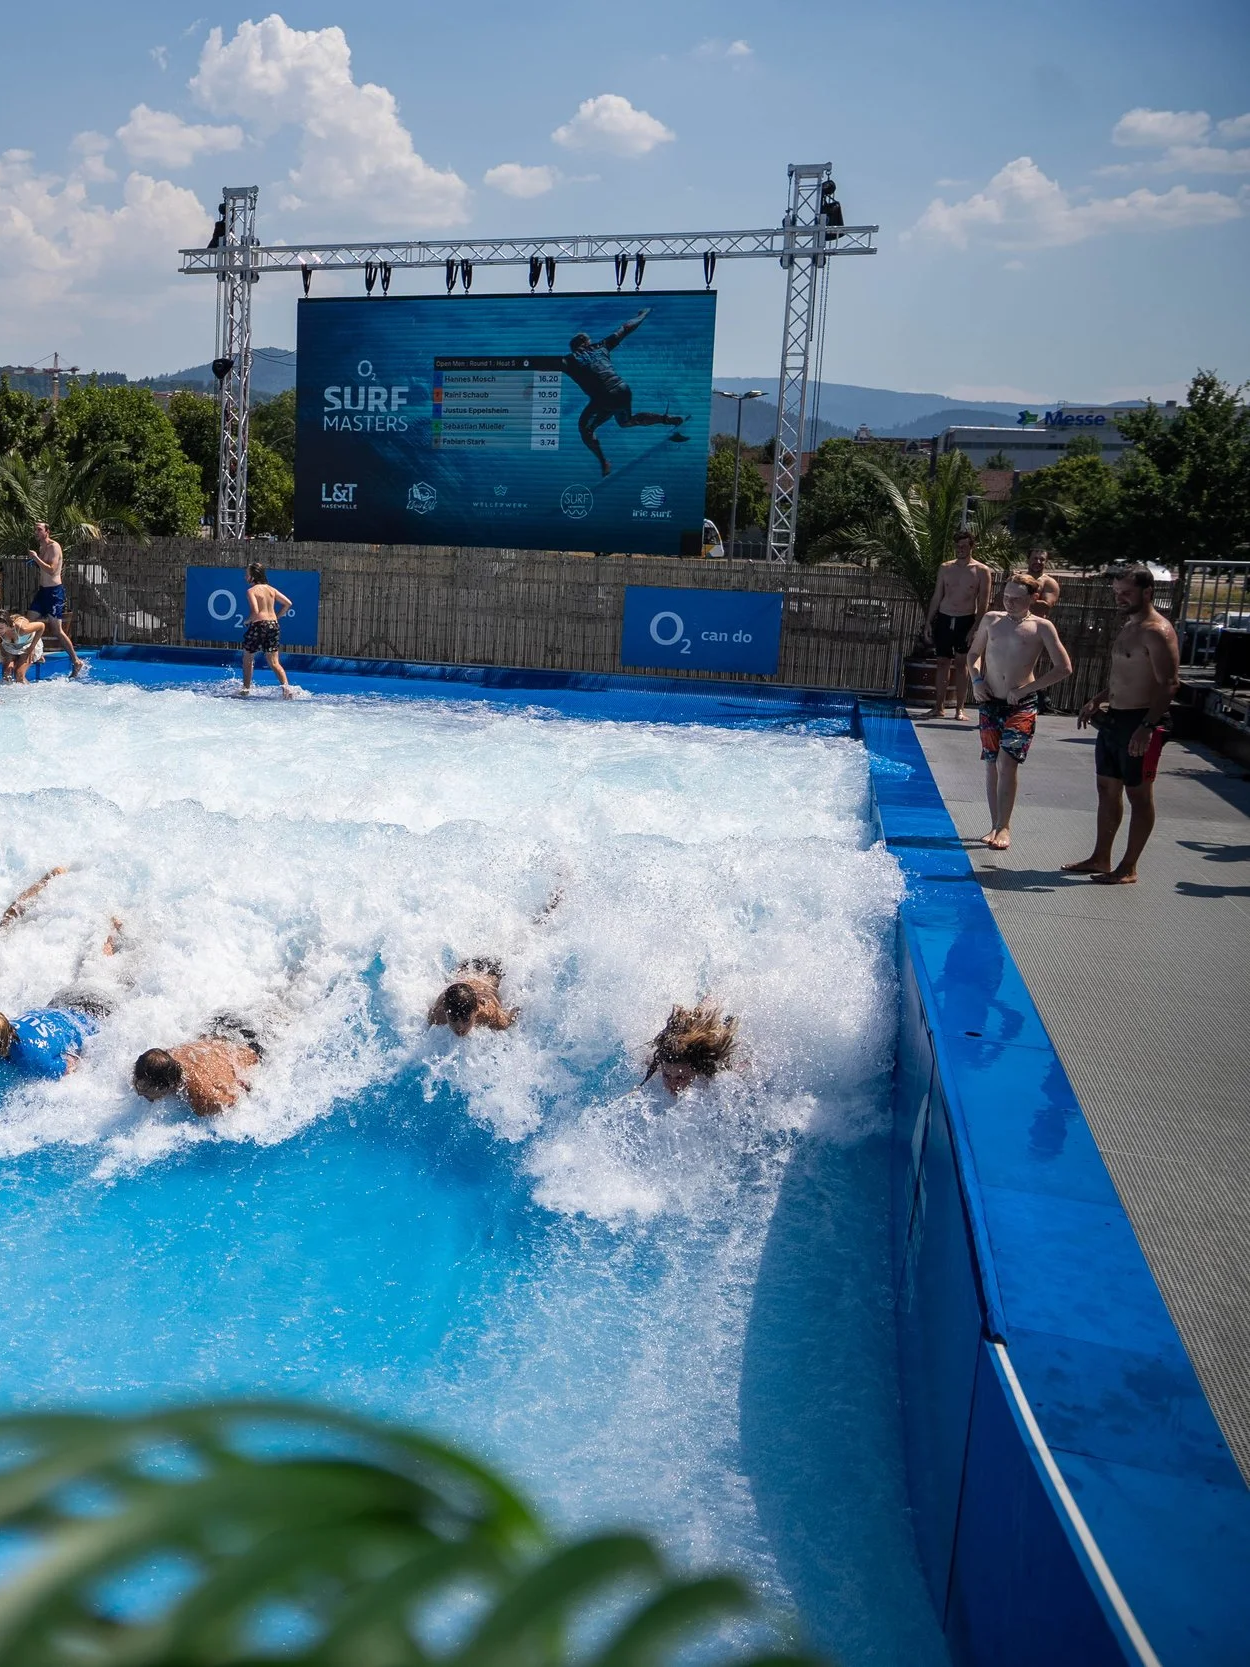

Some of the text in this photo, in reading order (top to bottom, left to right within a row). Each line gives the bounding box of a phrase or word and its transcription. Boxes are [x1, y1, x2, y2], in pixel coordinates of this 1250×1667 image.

[472, 375, 496, 383] Mosch
[323, 385, 409, 412] SURF
[323, 415, 408, 432] MASTERS
[1045, 411, 1106, 427] Messe
[321, 483, 358, 502] L&T
[564, 492, 590, 505] SURF
[701, 631, 728, 642] can
[732, 630, 753, 643] do
